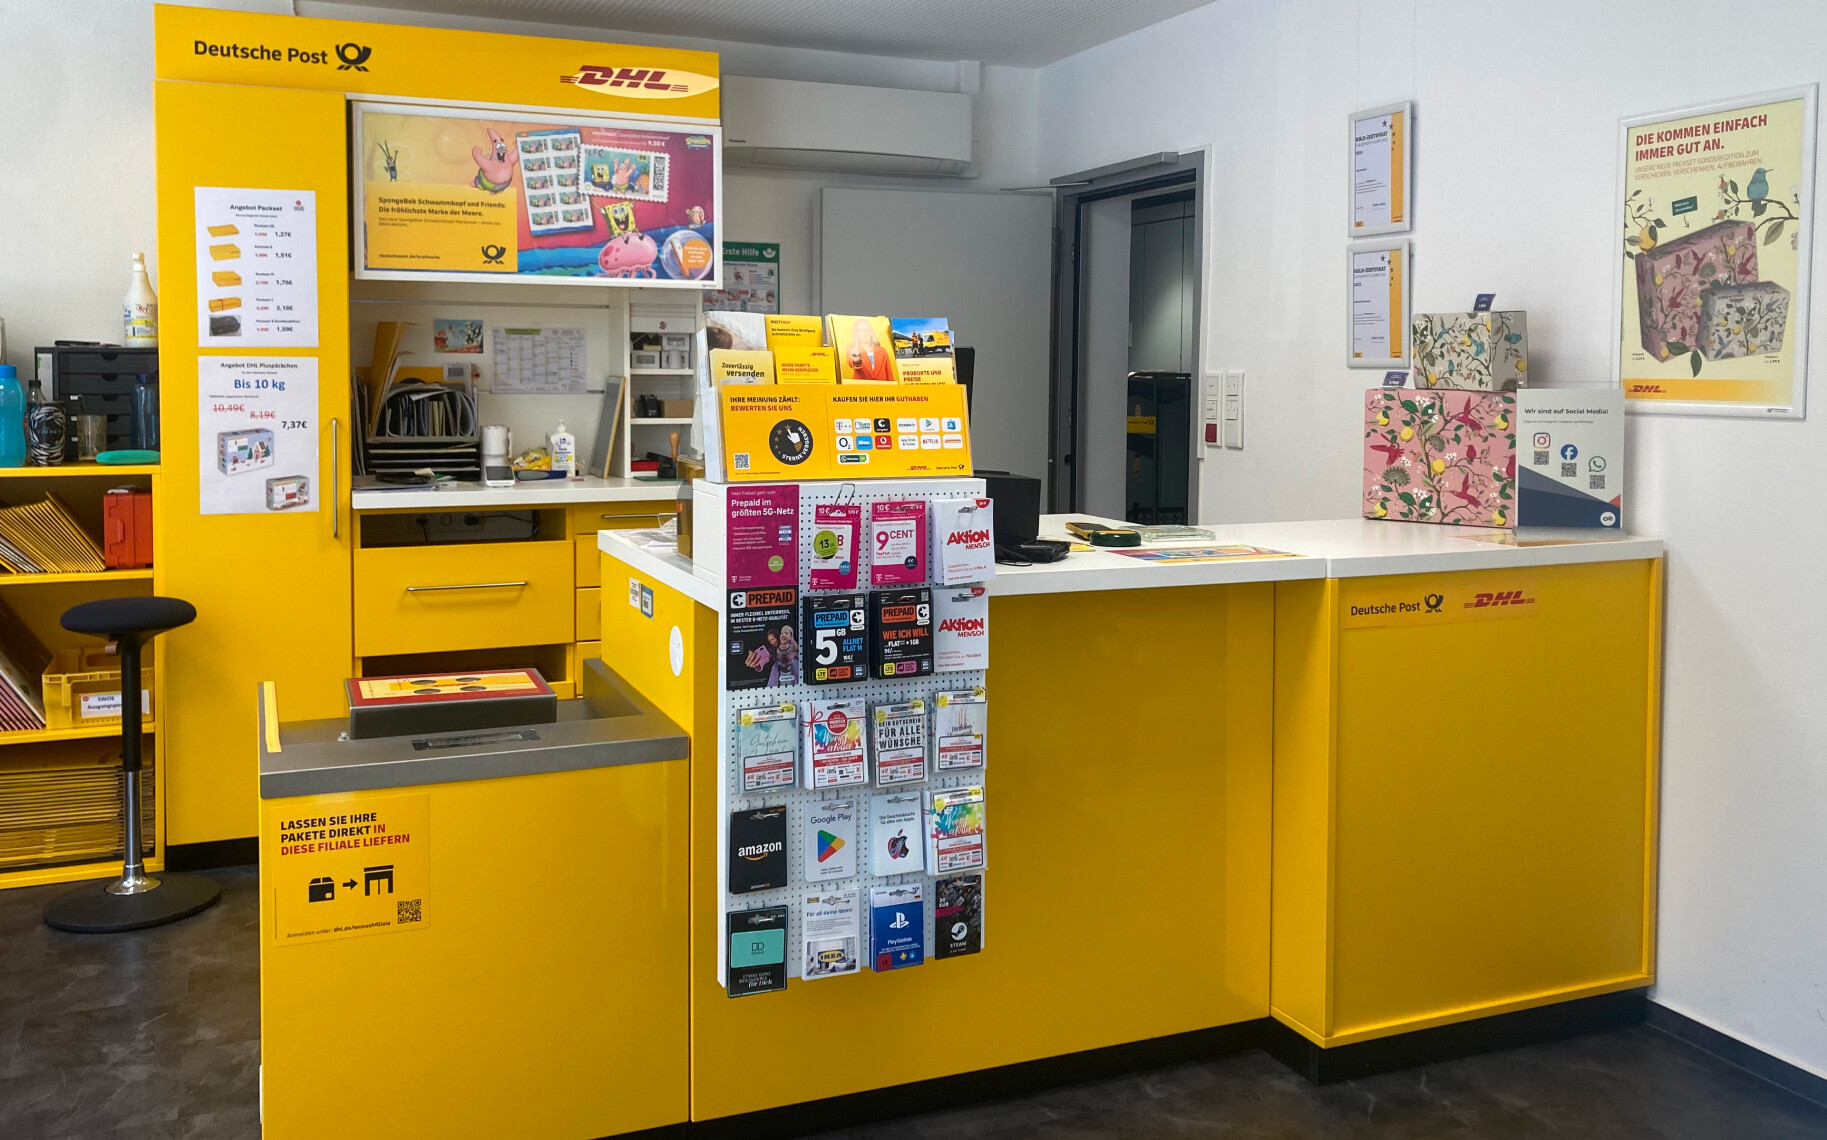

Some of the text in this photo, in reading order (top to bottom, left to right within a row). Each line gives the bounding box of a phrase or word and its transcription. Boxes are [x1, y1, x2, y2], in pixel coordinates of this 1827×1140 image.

[194, 40, 328, 65] Deutsche Post
[576, 64, 673, 91] DHL
[1636, 114, 1767, 146] DIE KOMMEN EINFACH
[1635, 138, 1724, 162] IMMER GUT AN.
[1634, 164, 1656, 174] UNSERE
[1672, 159, 1696, 168] PACKSET
[1698, 152, 1744, 164] SONDEREDITION
[1746, 150, 1759, 159] ZUM
[378, 197, 417, 206] SpongeBob
[418, 199, 467, 208] Schwammkopf
[722, 363, 754, 371] Zuverlässig
[234, 379, 285, 391] Bis 10 kg
[1632, 384, 1662, 393] DHL
[213, 404, 245, 413] 10,49€
[250, 411, 276, 420] 8,19€
[281, 421, 307, 430] 7,37€
[731, 499, 760, 508] Prepaid
[731, 509, 761, 518] größten
[819, 539, 830, 549] 13
[876, 531, 889, 550] 9
[890, 530, 914, 539] CENT
[966, 542, 990, 550] MENSCH
[748, 594, 792, 605] PREPAID
[1472, 590, 1528, 608] DHL
[883, 608, 914, 617] PREPAID
[1351, 601, 1420, 616] Deutsche Post
[816, 612, 847, 622] PREPAID
[883, 628, 928, 640] WIE ICH WILL
[816, 629, 838, 665] 5
[892, 718, 921, 726] GUTSCHEIN
[879, 725, 920, 738] FÜR ALLE
[879, 736, 921, 749] WÜNSCHE
[281, 812, 377, 831] LASSEN SIE IHRE
[810, 816, 836, 825] Google
[281, 824, 386, 843] PAKETE DIREKT IN
[281, 834, 410, 856] DIESE FILIALE LIEFERN
[738, 841, 782, 857] amazon
[333, 921, 390, 933] dhl.de/wunschfiliale
